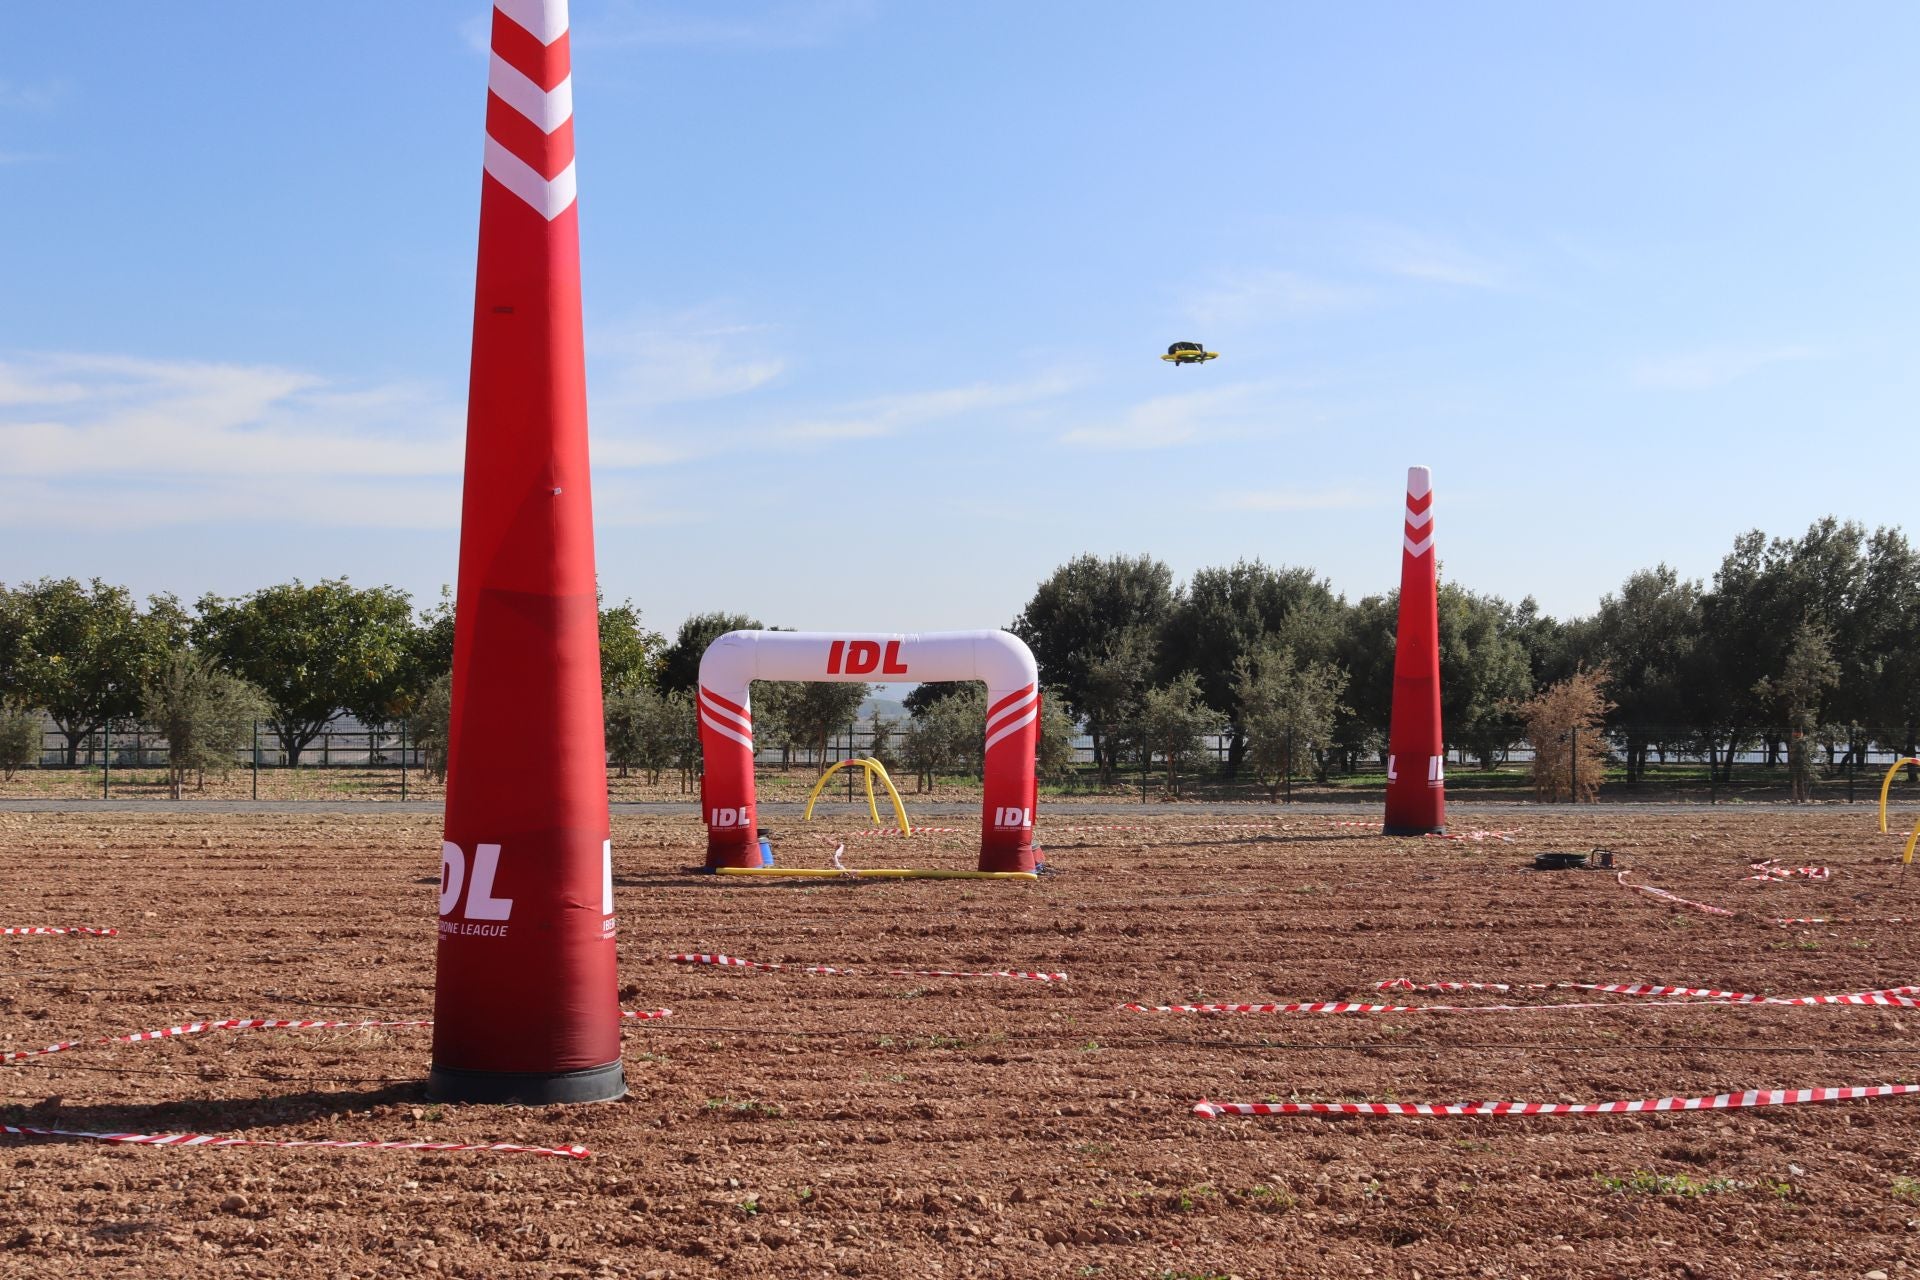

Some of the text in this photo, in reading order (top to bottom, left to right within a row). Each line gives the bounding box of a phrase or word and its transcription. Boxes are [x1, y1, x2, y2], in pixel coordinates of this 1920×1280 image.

[827, 640, 908, 675] IDL
[1387, 754, 1398, 780] L
[711, 806, 750, 827] IDL
[994, 807, 1032, 827] IDL
[439, 920, 509, 937] RONE LEAGUE
